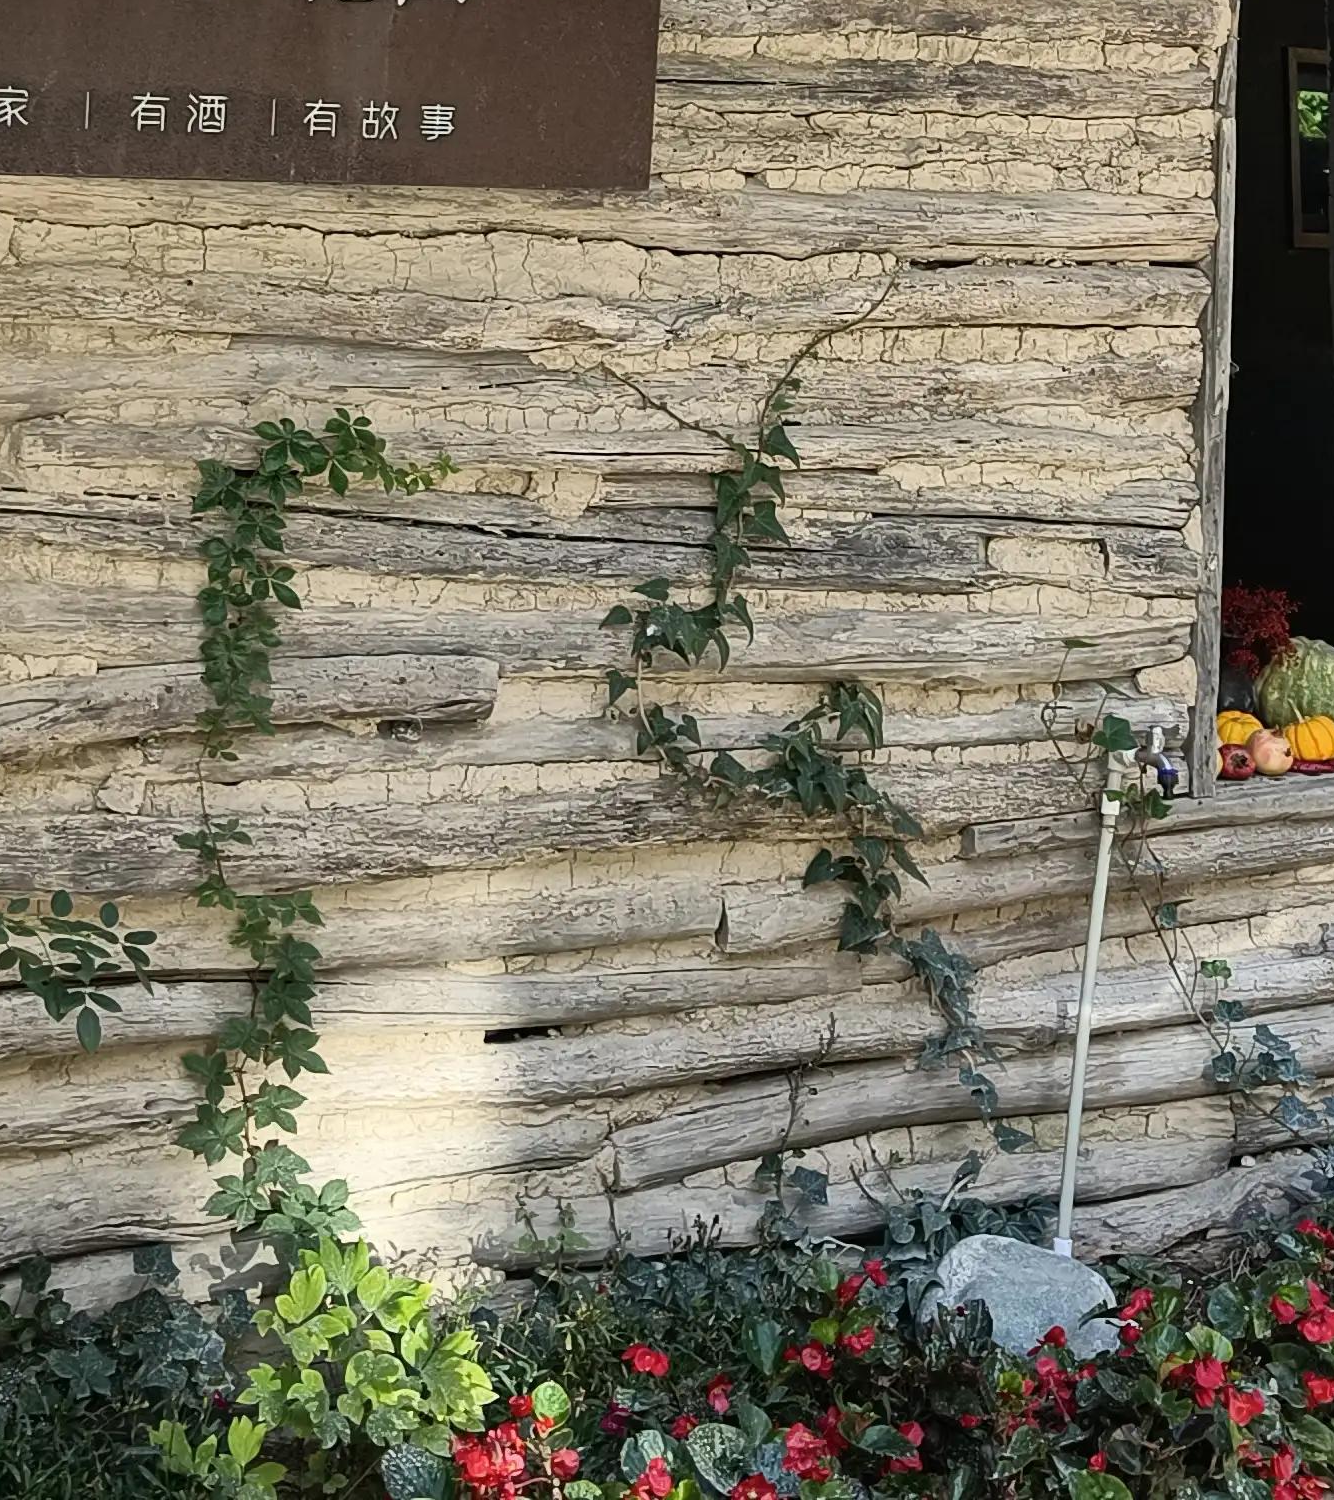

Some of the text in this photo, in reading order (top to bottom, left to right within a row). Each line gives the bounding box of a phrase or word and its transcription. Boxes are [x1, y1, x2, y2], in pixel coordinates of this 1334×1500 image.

[130, 91, 229, 133] 有酒
[303, 98, 456, 141] 有故事
